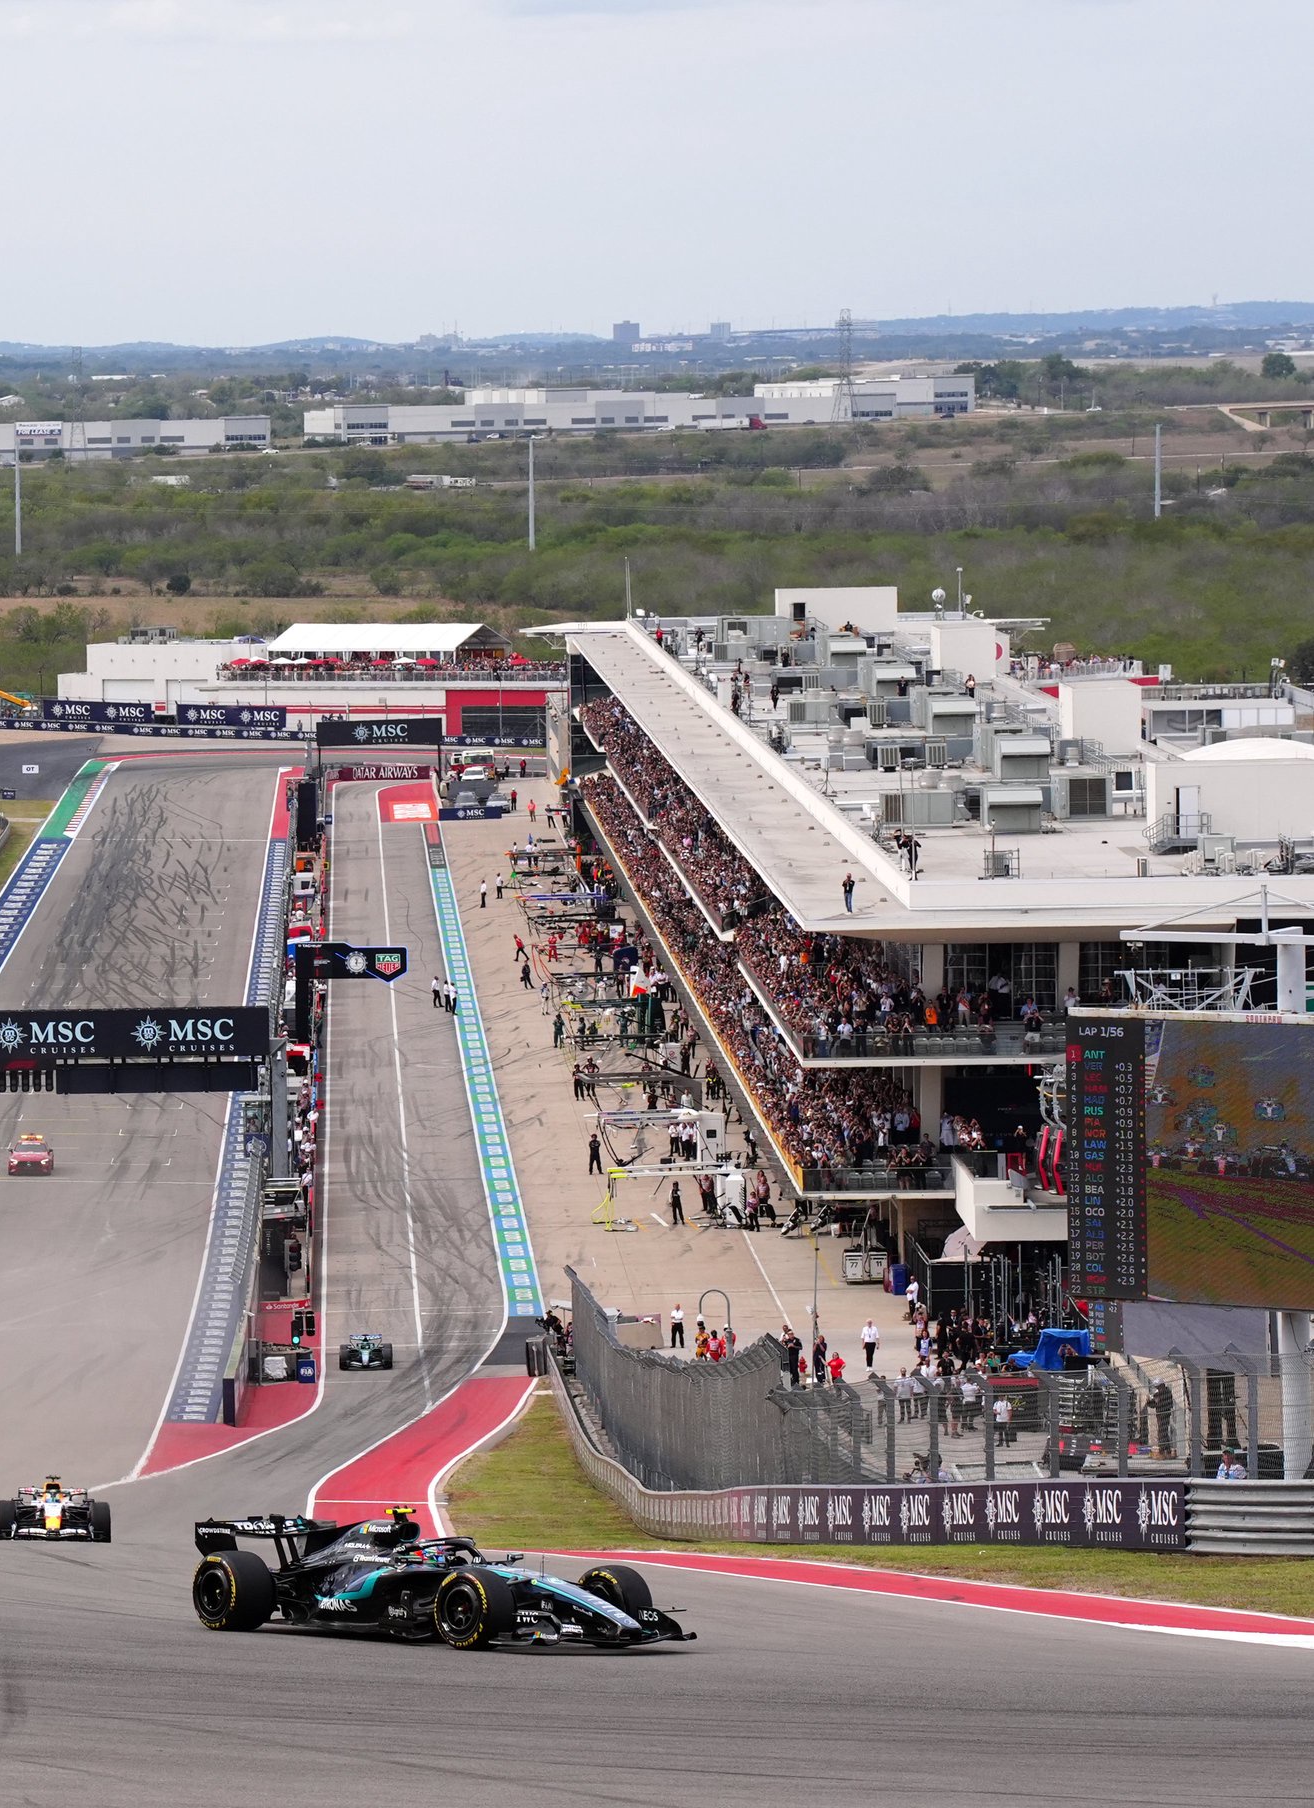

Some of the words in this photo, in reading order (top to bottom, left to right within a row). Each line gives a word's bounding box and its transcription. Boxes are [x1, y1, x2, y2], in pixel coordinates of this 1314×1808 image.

[66, 705, 90, 715] MSC
[120, 708, 144, 718] MSC
[200, 710, 226, 720] MSC
[254, 711, 279, 721] MSC
[373, 724, 408, 737] MSC
[353, 768, 376, 779] QATAR
[378, 766, 418, 779] AIRWAYS
[378, 964, 398, 974] HEUER
[30, 1021, 94, 1043] MSC
[168, 1018, 234, 1040] MSC
[1079, 1027, 1097, 1036] LAP
[1100, 1027, 1124, 1037] 1/56
[1072, 1050, 1076, 1058] 1
[1084, 1051, 1105, 1059] ANT
[1072, 1062, 1076, 1070] 2
[1115, 1063, 1132, 1071] +0.3
[1115, 1074, 1132, 1082] +0.5
[1116, 1086, 1132, 1094] +0.7
[1116, 1097, 1132, 1105] +0.7
[1084, 1107, 1104, 1115] RUS
[1116, 1108, 1132, 1116] +0.9
[1116, 1120, 1133, 1128] +0.9
[1116, 1131, 1133, 1139] +1.0
[1084, 1140, 1106, 1148] LAW
[1116, 1142, 1134, 1150] +1.5
[1084, 1152, 1104, 1160] GAS
[1116, 1153, 1133, 1161] +1.3
[1116, 1164, 1133, 1172] +2.3
[1085, 1185, 1104, 1194] BEA
[1116, 1187, 1134, 1195] +1.8
[1085, 1196, 1100, 1204] LIN
[1116, 1198, 1134, 1206] +2.0
[1086, 1208, 1104, 1216] OCO
[1116, 1210, 1134, 1218] +2.0
[1070, 1218, 1080, 1226] 16
[1116, 1221, 1134, 1229] +2.1
[1070, 1230, 1080, 1238] 17
[1116, 1232, 1134, 1240] +2.2
[1071, 1240, 1080, 1248] 18
[1086, 1241, 1104, 1250] PER
[1116, 1243, 1134, 1252] +2.5
[1086, 1252, 1106, 1260] BOT
[1117, 1254, 1134, 1262] +2.6
[1071, 1263, 1080, 1271] 20
[1086, 1264, 1104, 1272] COL
[1117, 1266, 1134, 1274] +2.6
[1072, 1274, 1080, 1282] 21
[1118, 1276, 1134, 1285] +2.9
[1072, 1286, 1081, 1294] 22
[1086, 1286, 1106, 1294] STR
[273, 1302, 300, 1310] Santander
[778, 1496, 790, 1524] MSC
[804, 1496, 820, 1525] MSC
[835, 1496, 852, 1525] MSC
[872, 1495, 890, 1526] MSC
[910, 1494, 930, 1526] MSC
[952, 1492, 974, 1524] MSC
[996, 1490, 1020, 1522] MSC
[1044, 1490, 1070, 1524] MSC
[1096, 1490, 1122, 1524] MSC
[1151, 1490, 1178, 1526] MSC
[200, 1527, 231, 1535] CROWDSTRIKE
[368, 1524, 391, 1534] Microsoft
[804, 1532, 820, 1540] CRUISES
[835, 1532, 852, 1541] CRUISES
[872, 1532, 890, 1542] CRUISES
[910, 1532, 931, 1542] CRUISES
[954, 1532, 976, 1541] CRUISES
[998, 1530, 1020, 1540] CRUISES
[1046, 1531, 1070, 1541] CRUISES
[1096, 1531, 1122, 1542] CRUISES
[1151, 1533, 1178, 1544] CRUISES
[358, 1554, 390, 1563] TeamViewer
[638, 1610, 658, 1622] INEOS
